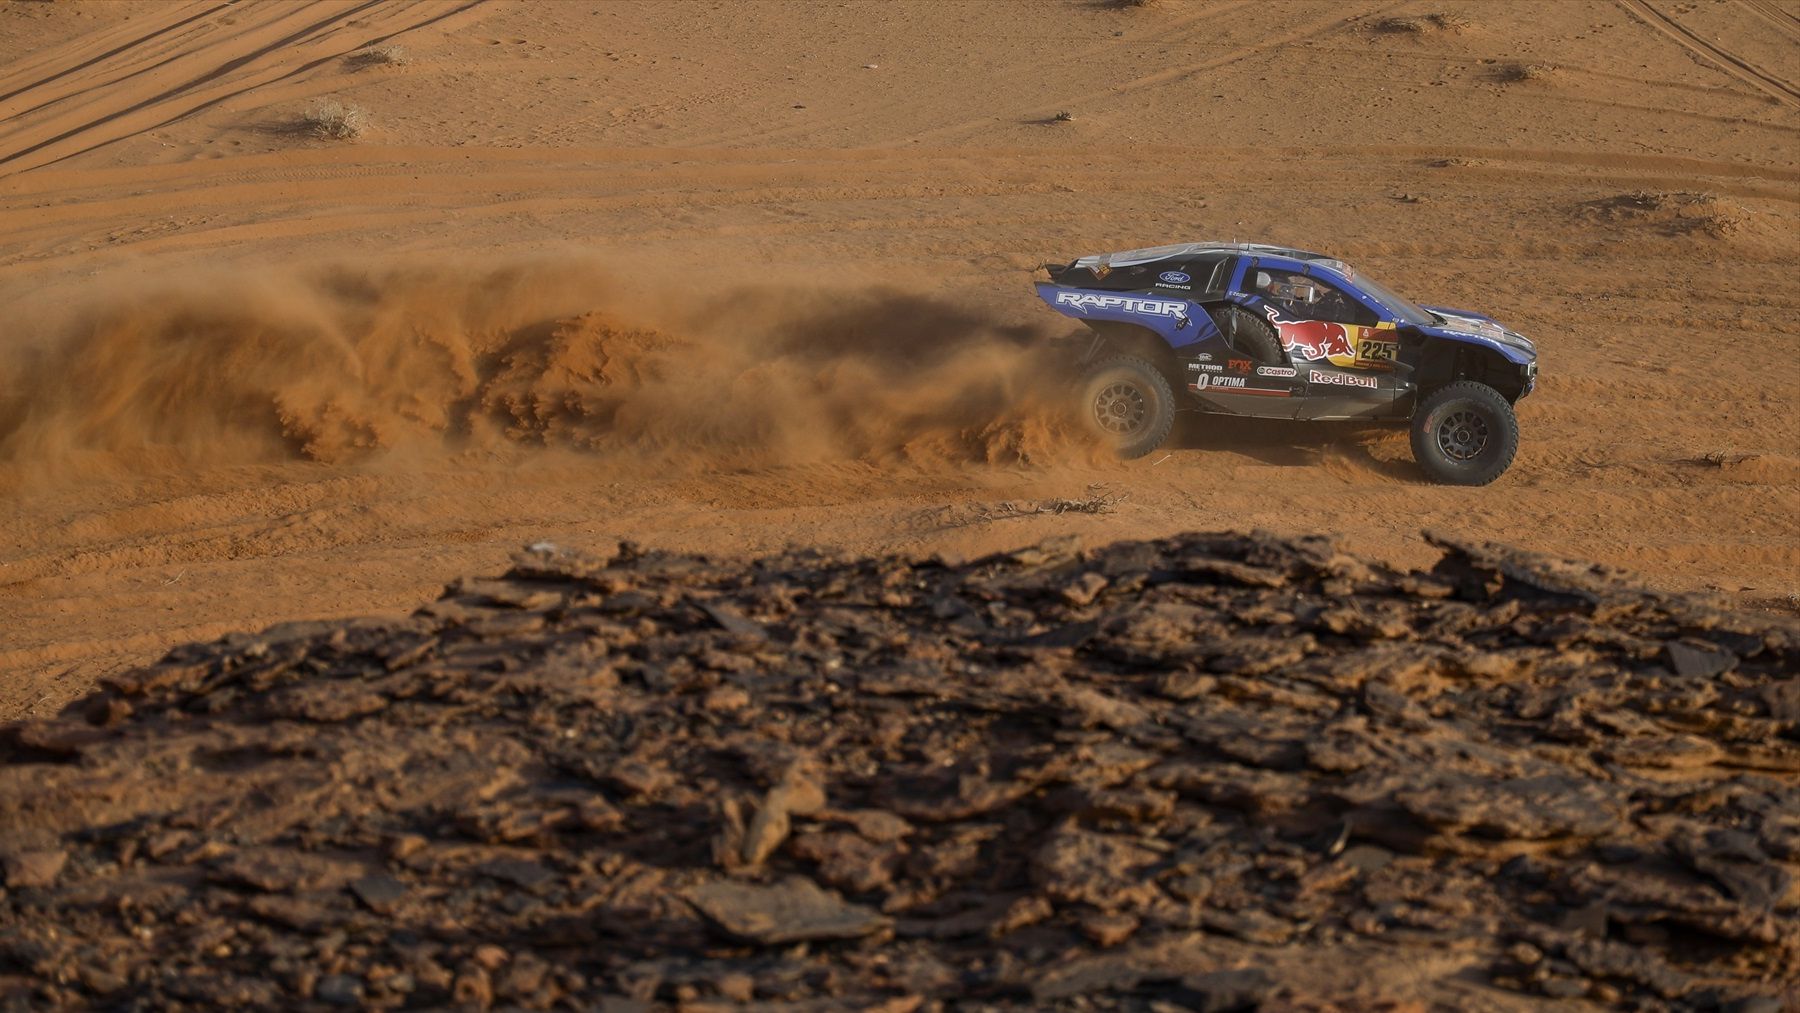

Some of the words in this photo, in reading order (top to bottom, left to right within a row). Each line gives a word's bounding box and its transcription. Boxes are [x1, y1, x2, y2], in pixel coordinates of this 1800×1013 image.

[1164, 272, 1184, 282] Ford
[1155, 282, 1191, 290] RACING
[1055, 291, 1192, 327] RAPTOR
[1361, 341, 1392, 360] 225
[1188, 363, 1223, 371] METHOD
[1228, 359, 1252, 371] FOX
[1265, 368, 1295, 376] Castrol
[1212, 376, 1245, 388] OPTIMA
[1309, 369, 1344, 385] Red
[1344, 375, 1378, 389] Bull
